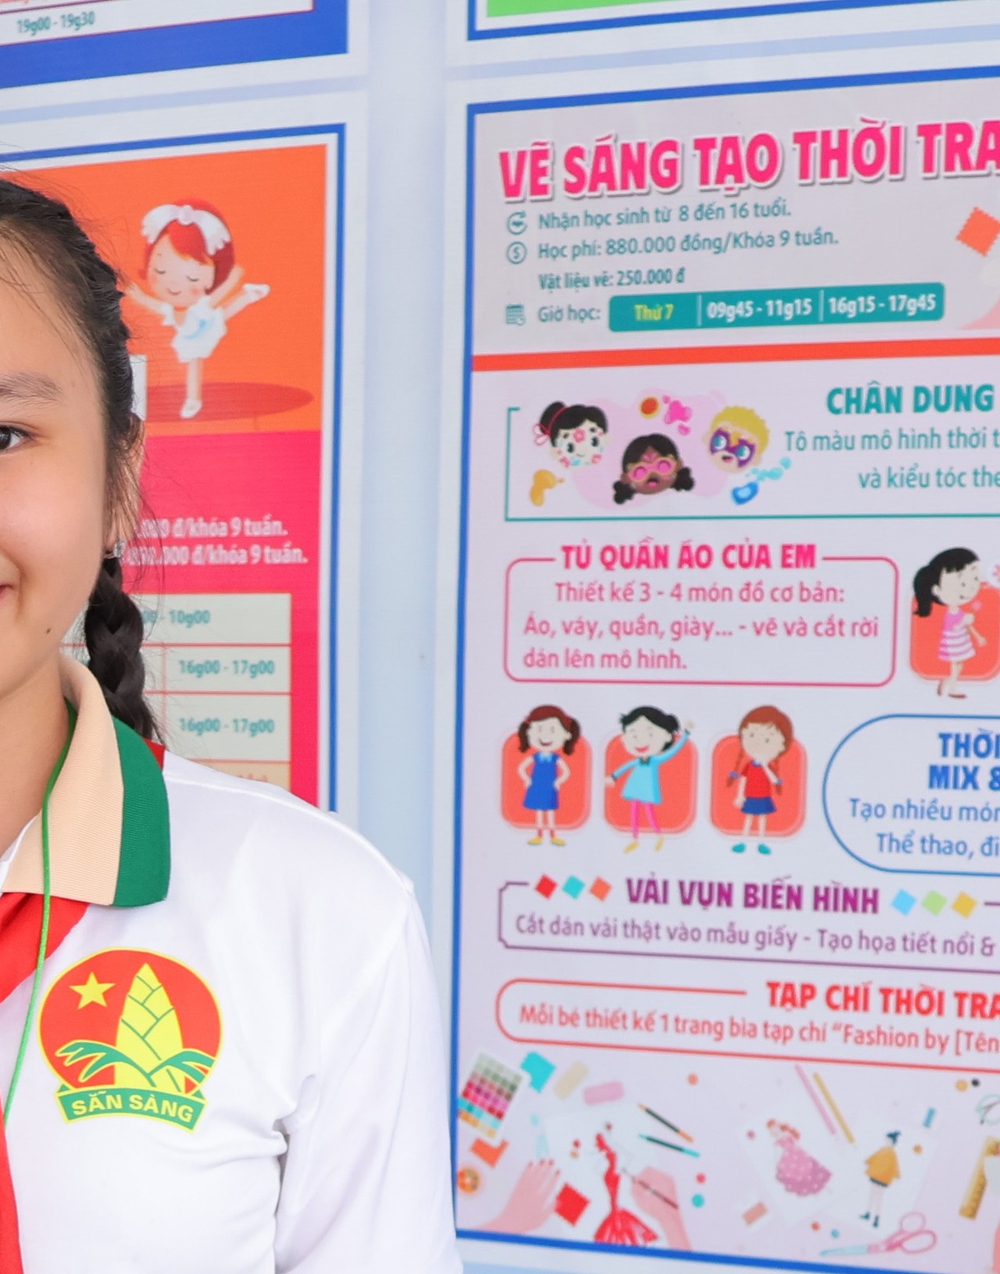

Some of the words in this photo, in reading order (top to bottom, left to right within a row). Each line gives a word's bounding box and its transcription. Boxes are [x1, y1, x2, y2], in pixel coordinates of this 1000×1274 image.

[499, 141, 551, 199] VẼ
[563, 135, 679, 194] SÁNG
[694, 133, 781, 193] TẠO
[793, 117, 901, 180] THỜI
[539, 213, 580, 230] Nhận
[583, 210, 612, 228] học
[617, 208, 650, 226] sinh
[654, 208, 671, 224] từ
[694, 204, 725, 222] đến
[729, 204, 749, 219] 16
[754, 199, 791, 218] tuổi.
[538, 242, 568, 261] Học
[572, 240, 602, 260] phí:
[606, 237, 676, 257] 880.000
[795, 228, 839, 246] tuần.
[538, 305, 562, 323] Giờ
[567, 305, 601, 324] học:
[708, 301, 753, 322] 09g45
[766, 299, 812, 319] 11g15
[829, 297, 874, 317] 16g15
[888, 295, 936, 315] 17g45
[827, 380, 901, 415] CHÂN
[914, 385, 993, 413] DUNG
[786, 431, 805, 451] Tô
[817, 430, 856, 451] màu
[862, 430, 894, 450] mô
[898, 427, 943, 450] hình
[947, 426, 987, 449] thời
[858, 471, 882, 488] và
[887, 464, 930, 488] kiểu
[935, 468, 965, 488] tóc
[561, 536, 591, 570] TỦ
[600, 536, 670, 570] QUẦN
[677, 538, 713, 570] ÁO
[722, 535, 771, 569] CỦA
[781, 544, 816, 569] EM
[555, 582, 605, 603] Thiết
[610, 582, 635, 603] kế
[688, 582, 733, 603] món
[738, 579, 765, 603] đồ
[769, 584, 792, 603] cơ
[799, 579, 844, 603] bản:
[524, 613, 556, 638] Áo,
[561, 618, 603, 642] váy,
[608, 613, 665, 642] quần,
[753, 618, 777, 637] vẽ
[782, 618, 807, 637] và
[814, 616, 846, 637] cắt
[851, 618, 879, 637] rời
[524, 649, 561, 669] dán
[564, 649, 594, 669] lên
[600, 649, 631, 669] mô
[637, 649, 686, 670] hình.
[627, 871, 669, 905] VẢI
[678, 879, 733, 910] VỤN
[743, 876, 803, 911] BIẾN
[813, 880, 879, 915] HÌNH
[515, 914, 545, 935] Cắt
[550, 916, 584, 938] dán
[589, 917, 618, 938] vải
[622, 919, 661, 943] thật
[666, 922, 700, 943] vào
[706, 922, 751, 946] mẫu
[755, 922, 798, 952] giấy
[817, 930, 852, 953] Tạo
[857, 929, 897, 956] họa
[901, 930, 935, 953] tiết
[942, 929, 973, 957] nổi
[766, 980, 817, 1013] TẠP
[824, 979, 870, 1013] CHÍ
[878, 983, 945, 1018] THỜI
[520, 1005, 554, 1026] Mỗi
[558, 1008, 581, 1028] bé
[584, 1007, 628, 1031] thiết
[632, 1008, 656, 1033] kế
[674, 1017, 725, 1041] trang
[728, 1015, 757, 1039] bìa
[762, 1019, 794, 1044] tạp
[799, 1020, 828, 1041] chí
[924, 1026, 950, 1053] by
[71, 1091, 122, 1116] SẴN
[129, 1094, 194, 1123] SÀNG
